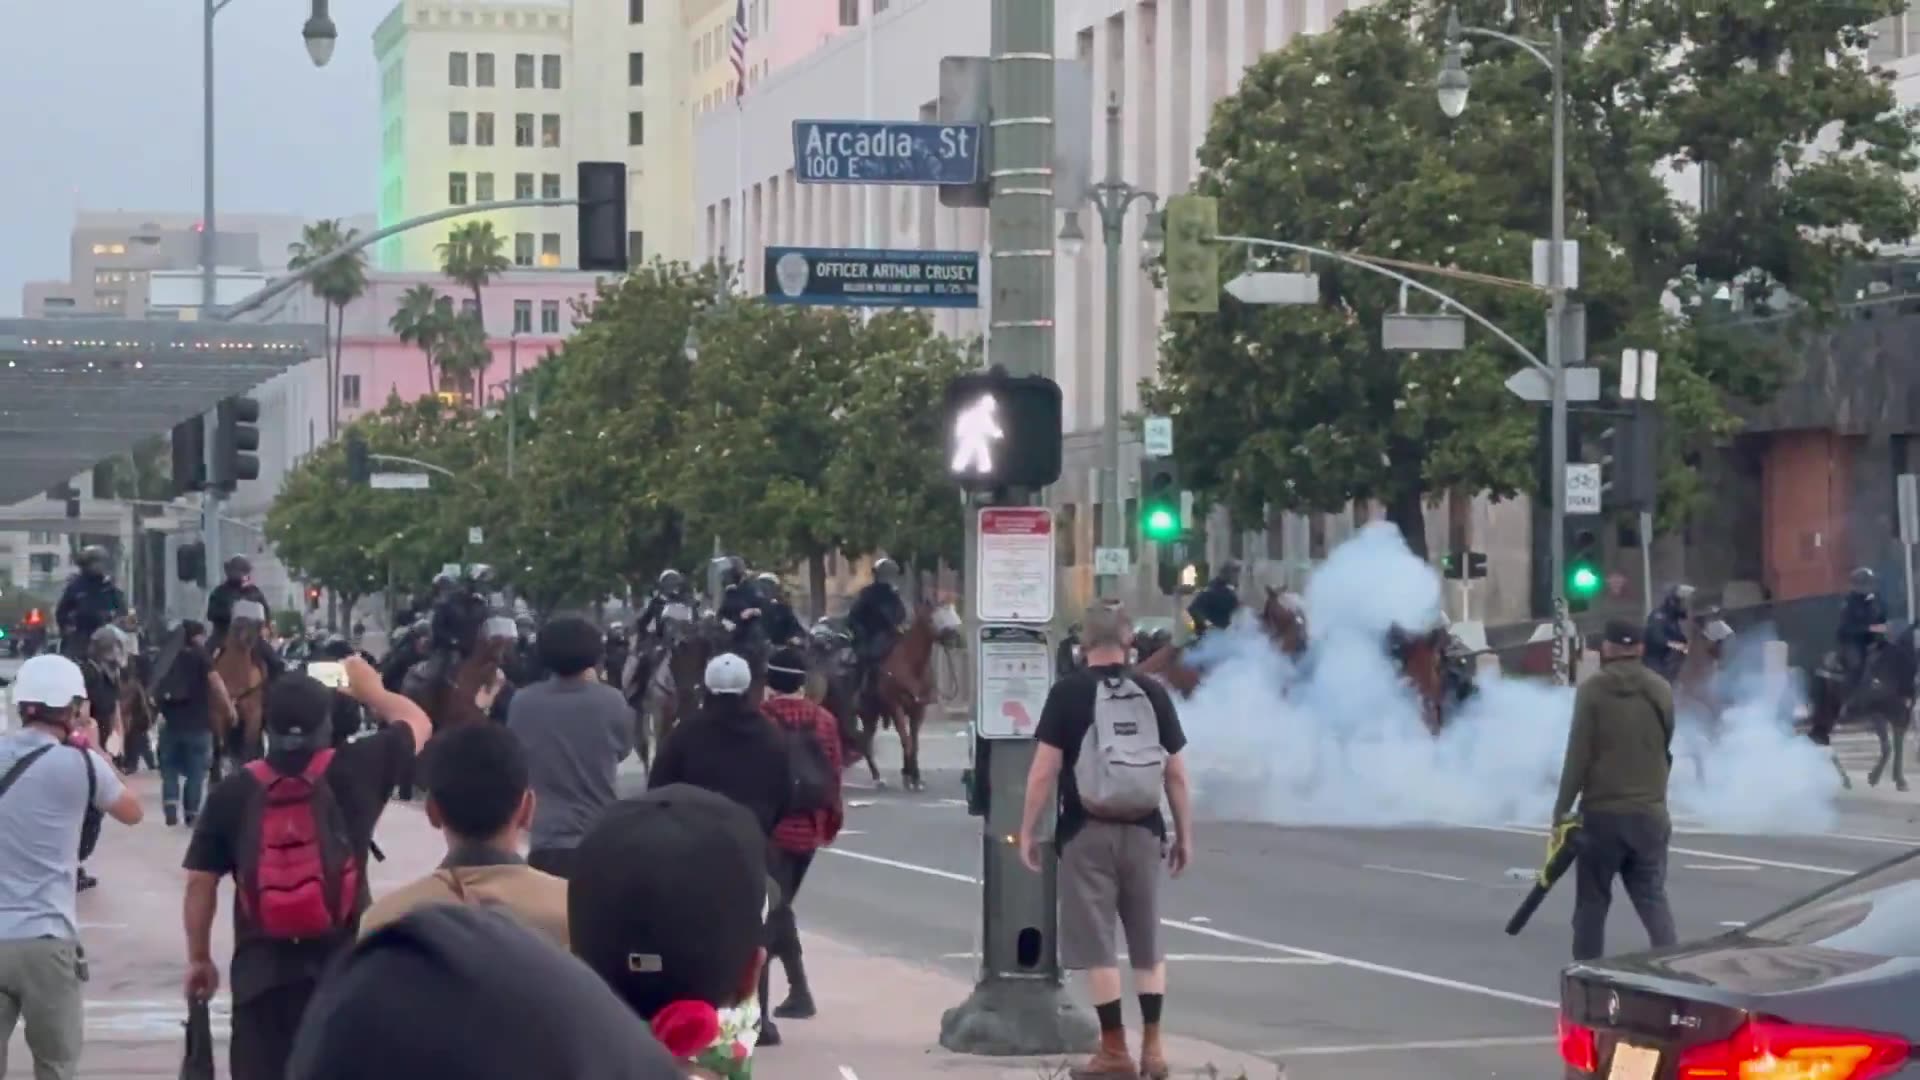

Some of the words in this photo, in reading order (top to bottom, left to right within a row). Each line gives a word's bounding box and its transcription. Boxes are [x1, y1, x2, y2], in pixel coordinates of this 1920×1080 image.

[806, 125, 912, 157] Arcadia
[939, 127, 969, 159] St
[807, 156, 838, 177] 100
[848, 156, 860, 177] E
[816, 262, 868, 277] OFFICER
[873, 263, 920, 279] ARTHUR
[926, 264, 975, 280] CRUSEY
